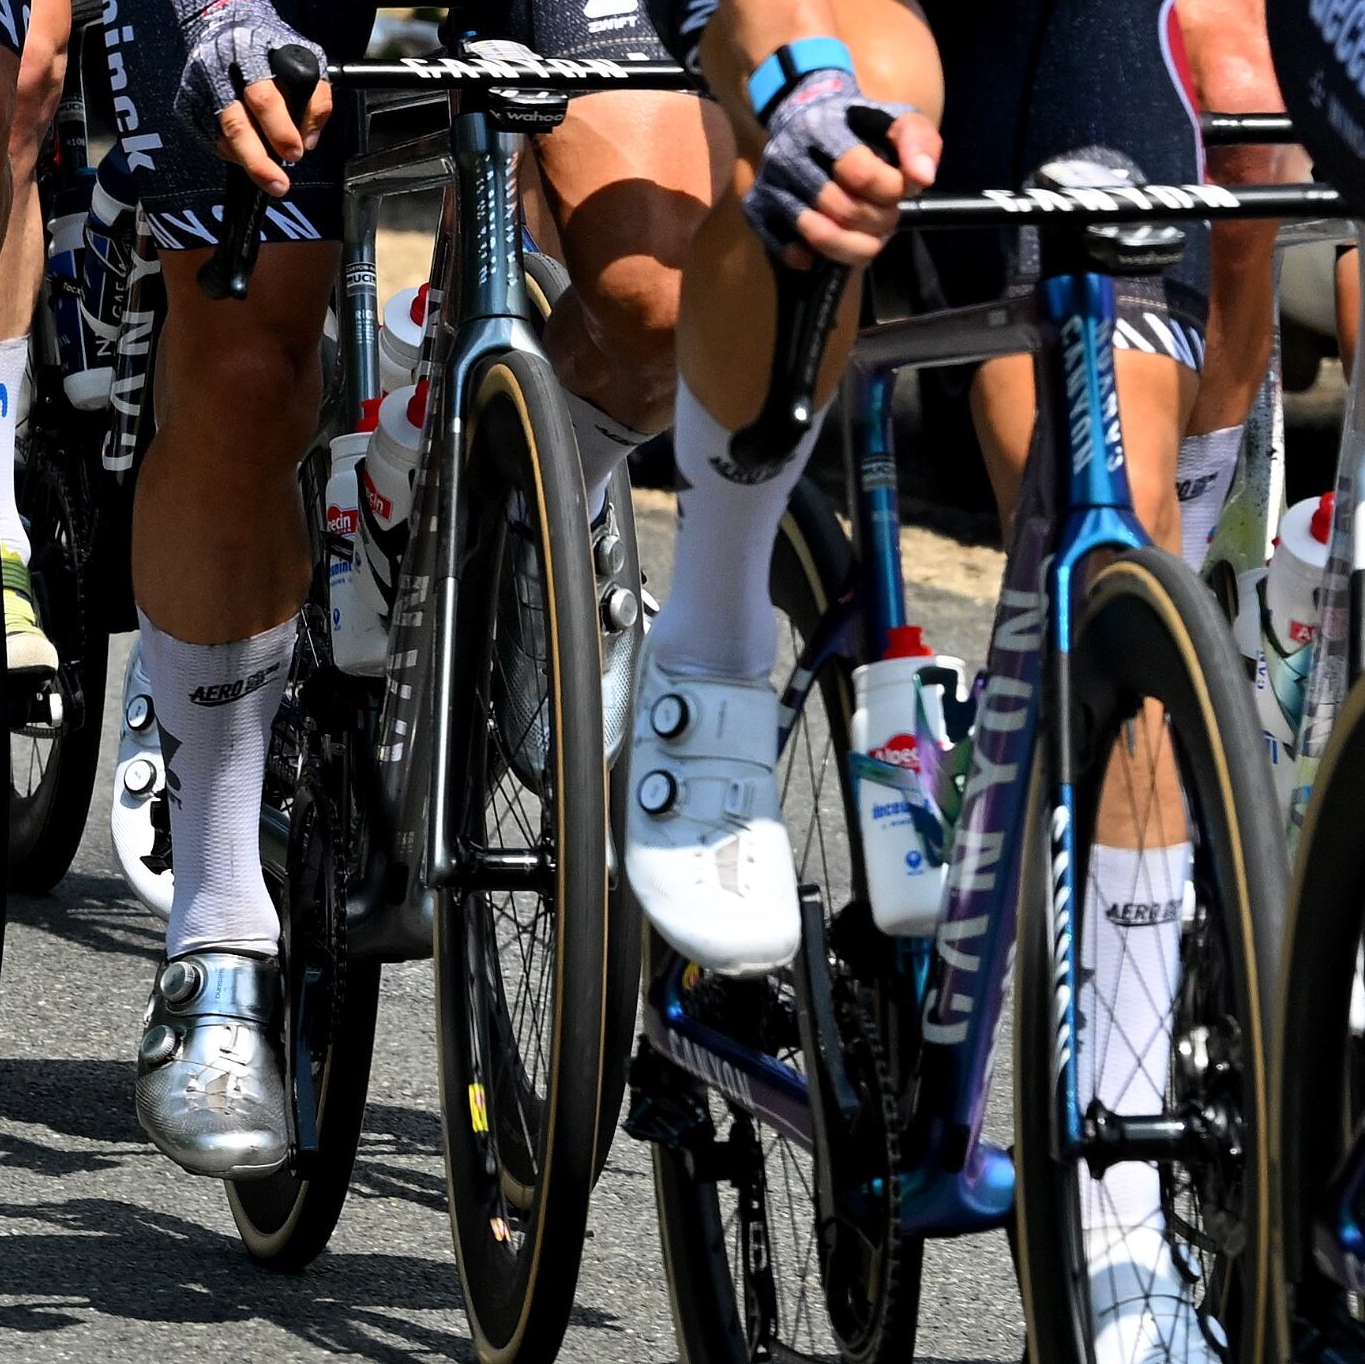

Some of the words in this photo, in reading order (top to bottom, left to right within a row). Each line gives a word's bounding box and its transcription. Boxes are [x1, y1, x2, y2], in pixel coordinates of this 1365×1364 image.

[588, 15, 638, 34] ZWIFT
[400, 57, 629, 79] CANYON
[507, 110, 565, 122] wahoo
[983, 186, 1242, 212] CANYON
[1062, 316, 1092, 475] CANYON
[190, 679, 245, 705] AERO
[923, 590, 1044, 1046] CANYON
